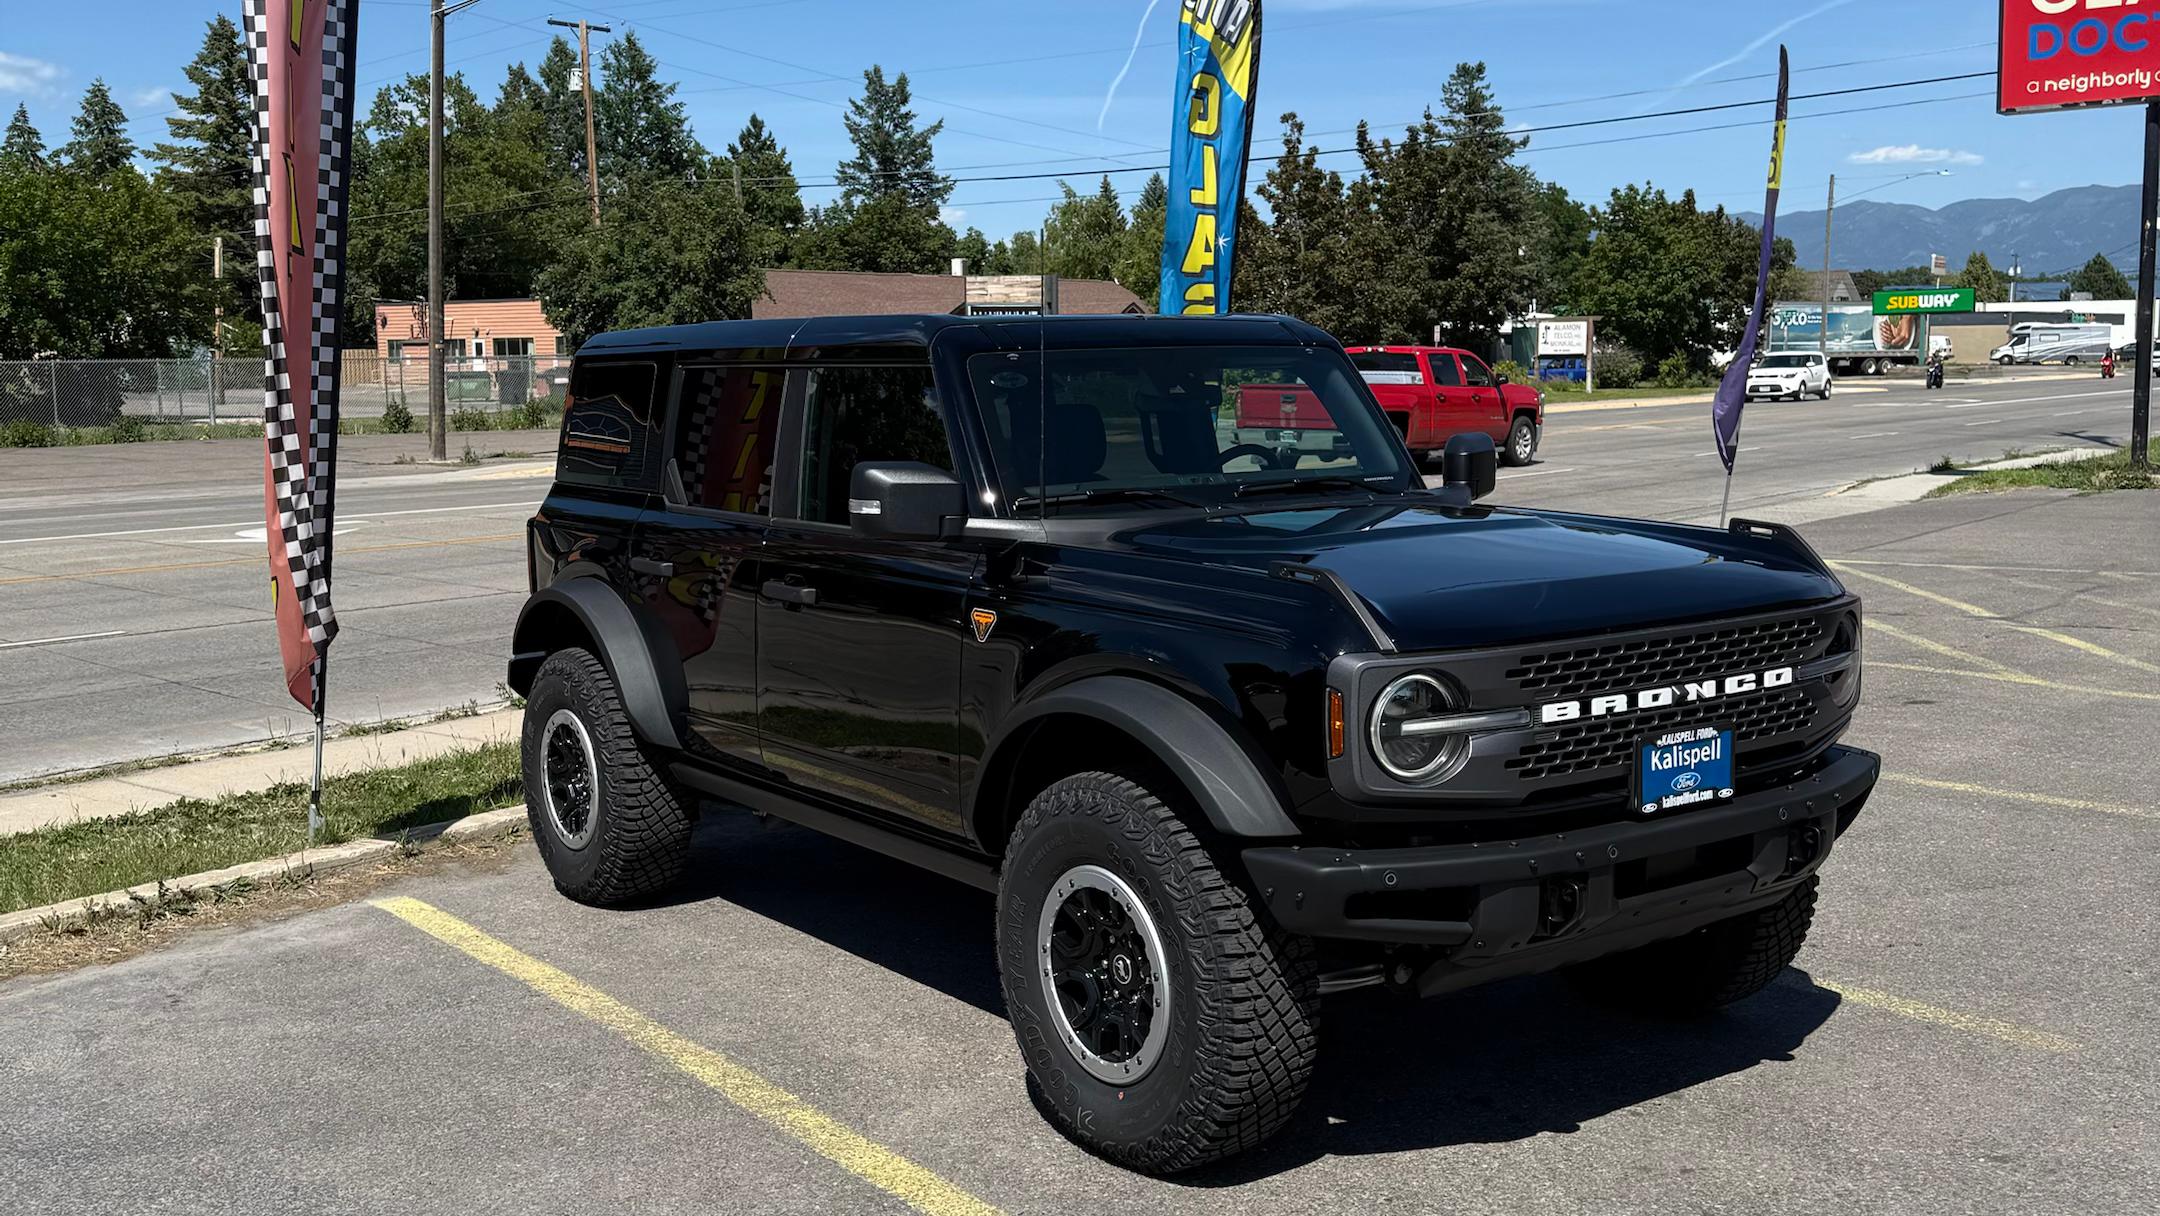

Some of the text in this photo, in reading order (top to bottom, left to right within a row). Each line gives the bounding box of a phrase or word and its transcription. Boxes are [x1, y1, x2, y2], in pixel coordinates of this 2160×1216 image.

[2027, 11, 2160, 61] DOC
[2026, 80, 2040, 94] a
[2044, 68, 2151, 93] neighborly
[1886, 293, 1960, 310] SUBWAY
[1541, 666, 1793, 723] BRONCO
[1661, 727, 1713, 746] KALISPELL FORD
[1651, 738, 1721, 771] Kalispell
[1662, 790, 1714, 809] kalispellford.com
